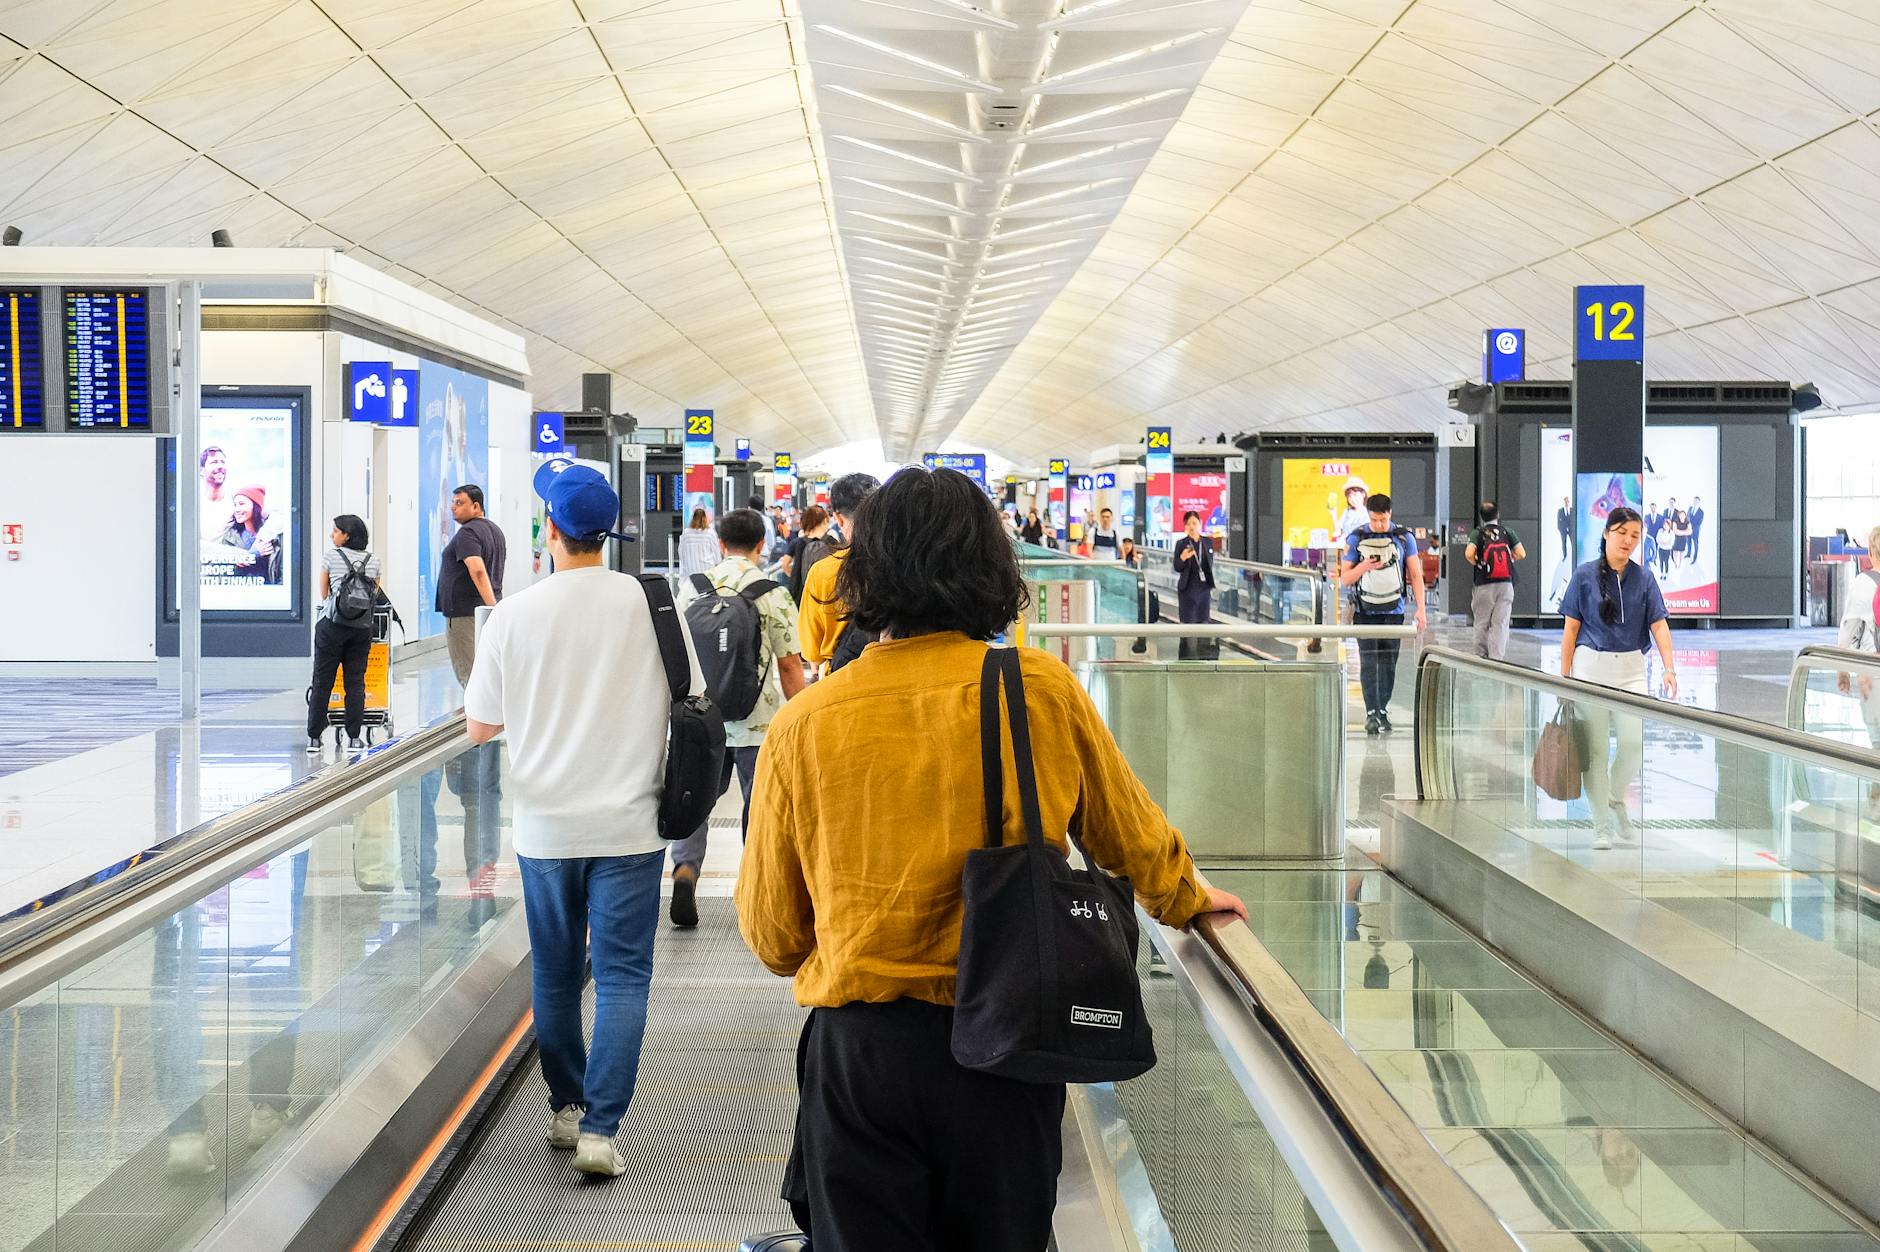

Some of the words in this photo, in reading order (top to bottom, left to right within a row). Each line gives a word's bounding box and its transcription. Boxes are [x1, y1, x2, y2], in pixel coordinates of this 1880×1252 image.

[1586, 302, 1635, 341] 12
[687, 416, 712, 435] 23
[1148, 431, 1169, 448] 24
[222, 576, 265, 586] FINNAIR
[1074, 1010, 1119, 1025] BROMPTON
